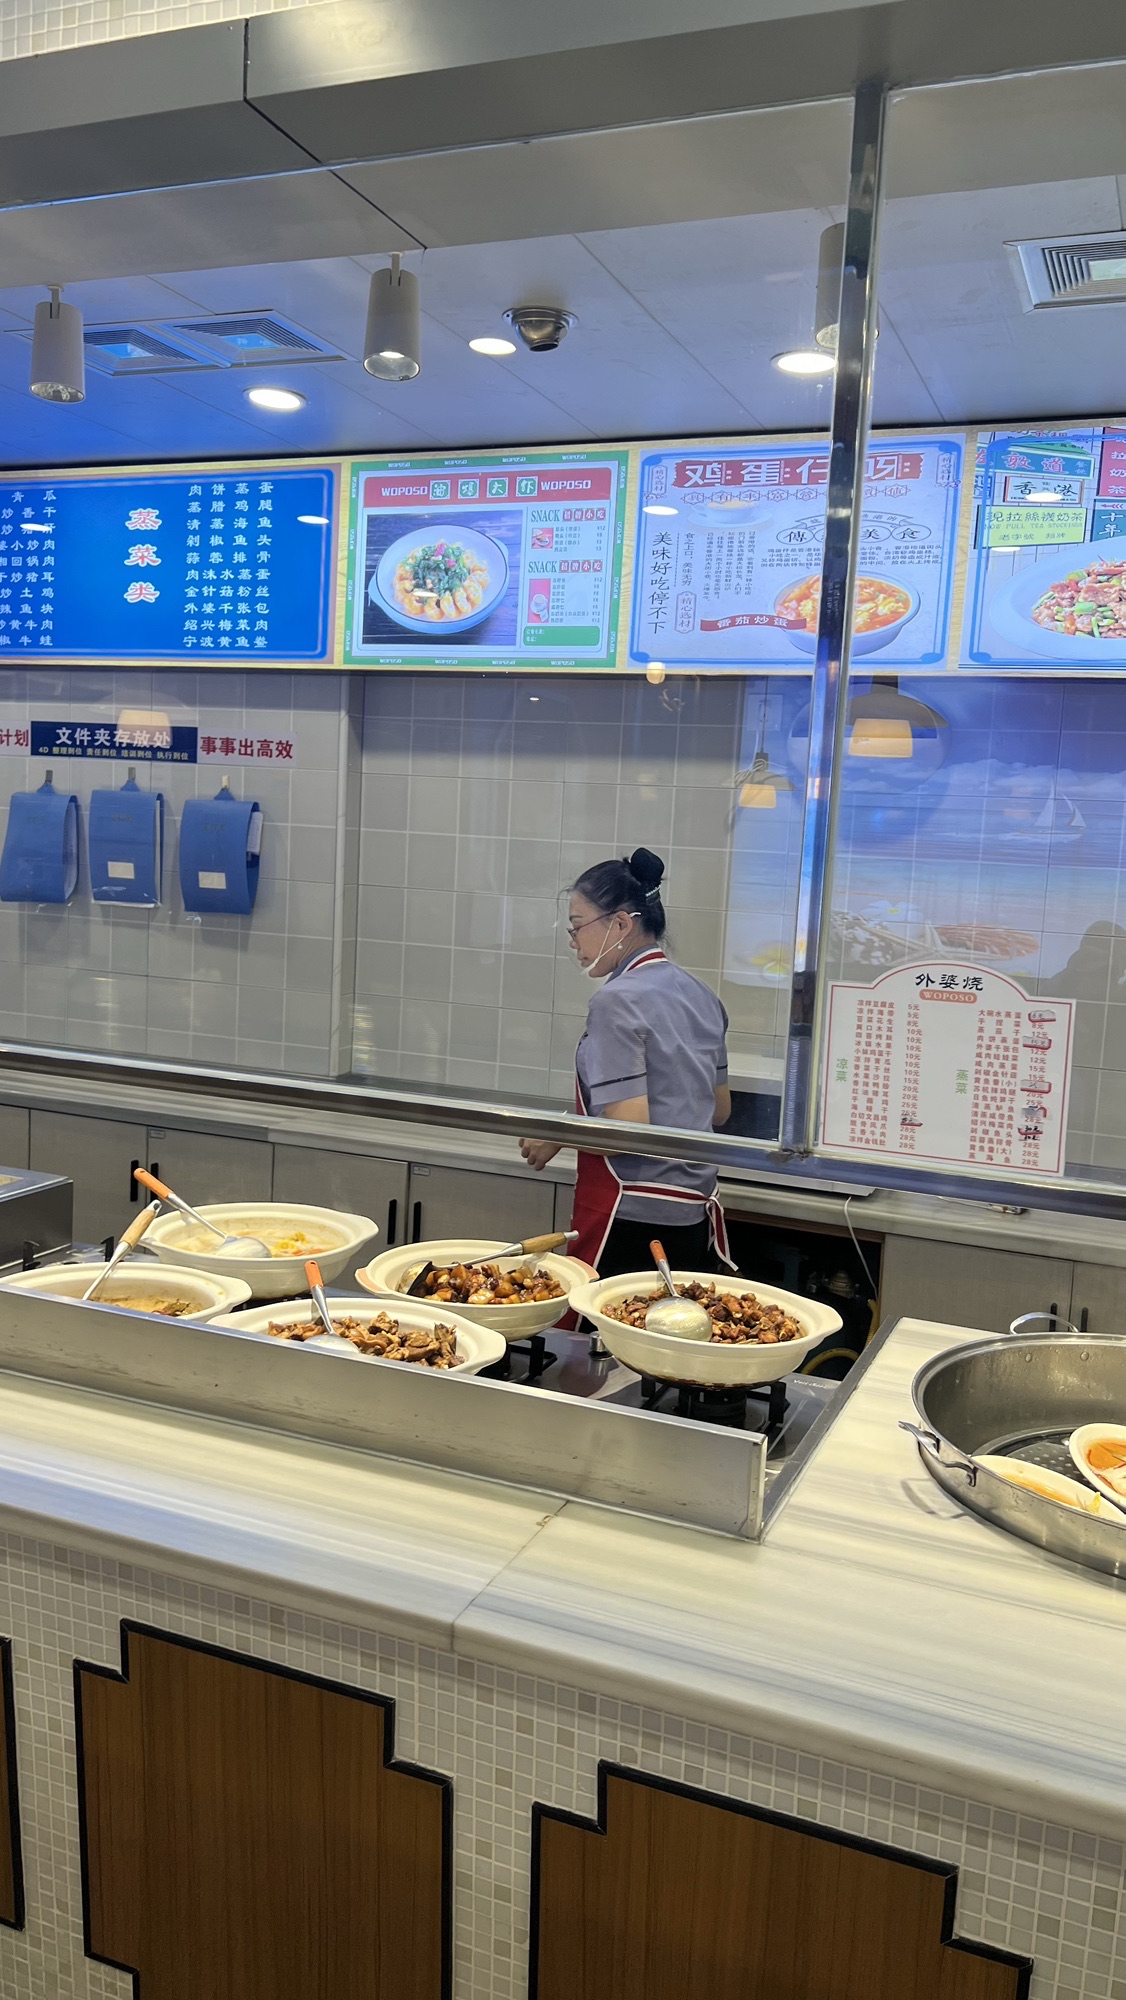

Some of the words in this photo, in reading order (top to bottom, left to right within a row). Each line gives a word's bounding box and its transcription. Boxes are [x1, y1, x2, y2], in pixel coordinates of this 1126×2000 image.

[188, 482, 274, 497] 肉饼蒸蛋
[381, 486, 428, 497] WOPOSO
[541, 480, 592, 491] WOPOSO
[11, 489, 57, 503] 青瓜
[187, 499, 273, 513] 蒸腊鸡腿
[531, 510, 560, 522] SNACK
[186, 516, 272, 530] 清蒸海鱼
[186, 534, 272, 547] 剁椒鱼头
[124, 508, 162, 603] 蒸菜类
[186, 551, 271, 564] 蒜蓉排骨
[528, 561, 557, 573] SNACK
[648, 531, 672, 634] 美味好吃停不下
[184, 585, 270, 597] 金针菇粉丝
[183, 602, 269, 614] 外婆千张包
[183, 619, 268, 631] 绍兴梅菜肉
[717, 614, 788, 629] 番茄炒蛋
[56, 727, 171, 749] 文件夹存放处
[200, 736, 293, 760] 事事出高效
[156, 751, 189, 761] 执行到位
[915, 973, 984, 991] 外婆烧
[923, 991, 974, 1002] WOPOSO
[905, 1061, 920, 1069] 10元
[1030, 1057, 1046, 1065] 12元
[836, 1057, 848, 1082] 凉菜
[904, 1069, 920, 1077] 10元
[956, 1069, 968, 1094] 蒸菜
[899, 1134, 915, 1142] 28元
[1023, 1142, 1040, 1150] 28元
[1022, 1150, 1039, 1158] 28元
